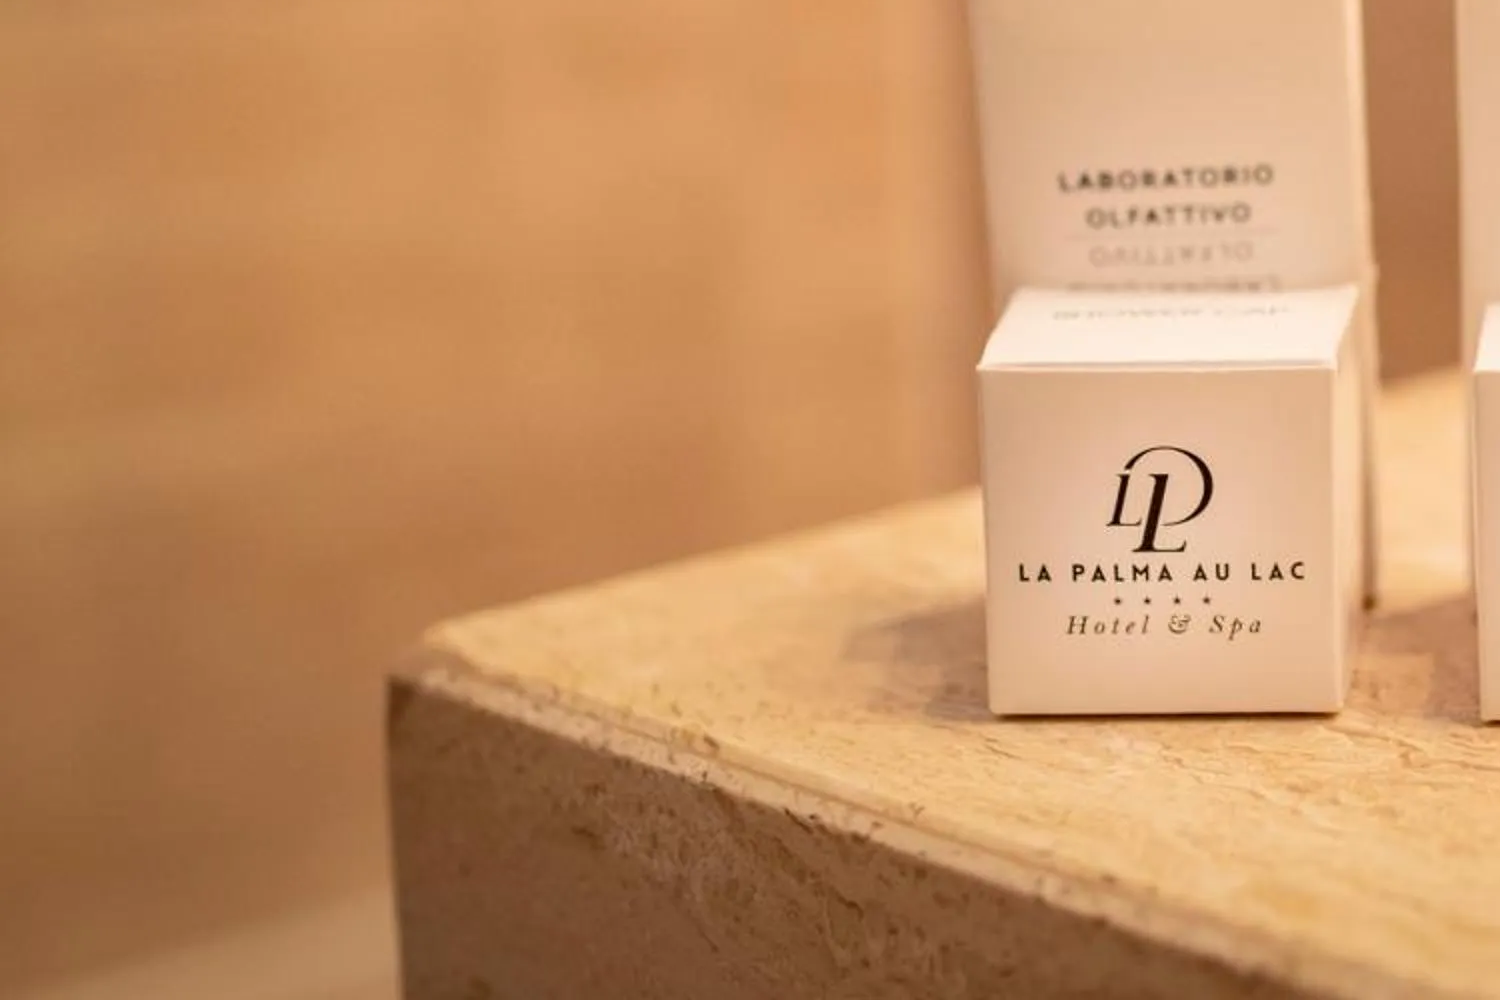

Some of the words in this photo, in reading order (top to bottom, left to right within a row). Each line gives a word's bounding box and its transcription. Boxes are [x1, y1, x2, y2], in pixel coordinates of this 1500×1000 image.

[1057, 164, 1274, 193] LABORATORIO
[1085, 203, 1251, 229] OLFATTIVO
[1018, 563, 1052, 583] LA
[1071, 563, 1173, 583] PALMA
[1192, 563, 1230, 582] AU
[1250, 561, 1305, 581] LAC
[1066, 614, 1150, 635] Hotel
[1167, 614, 1192, 635] &
[1208, 615, 1262, 641] Spa
